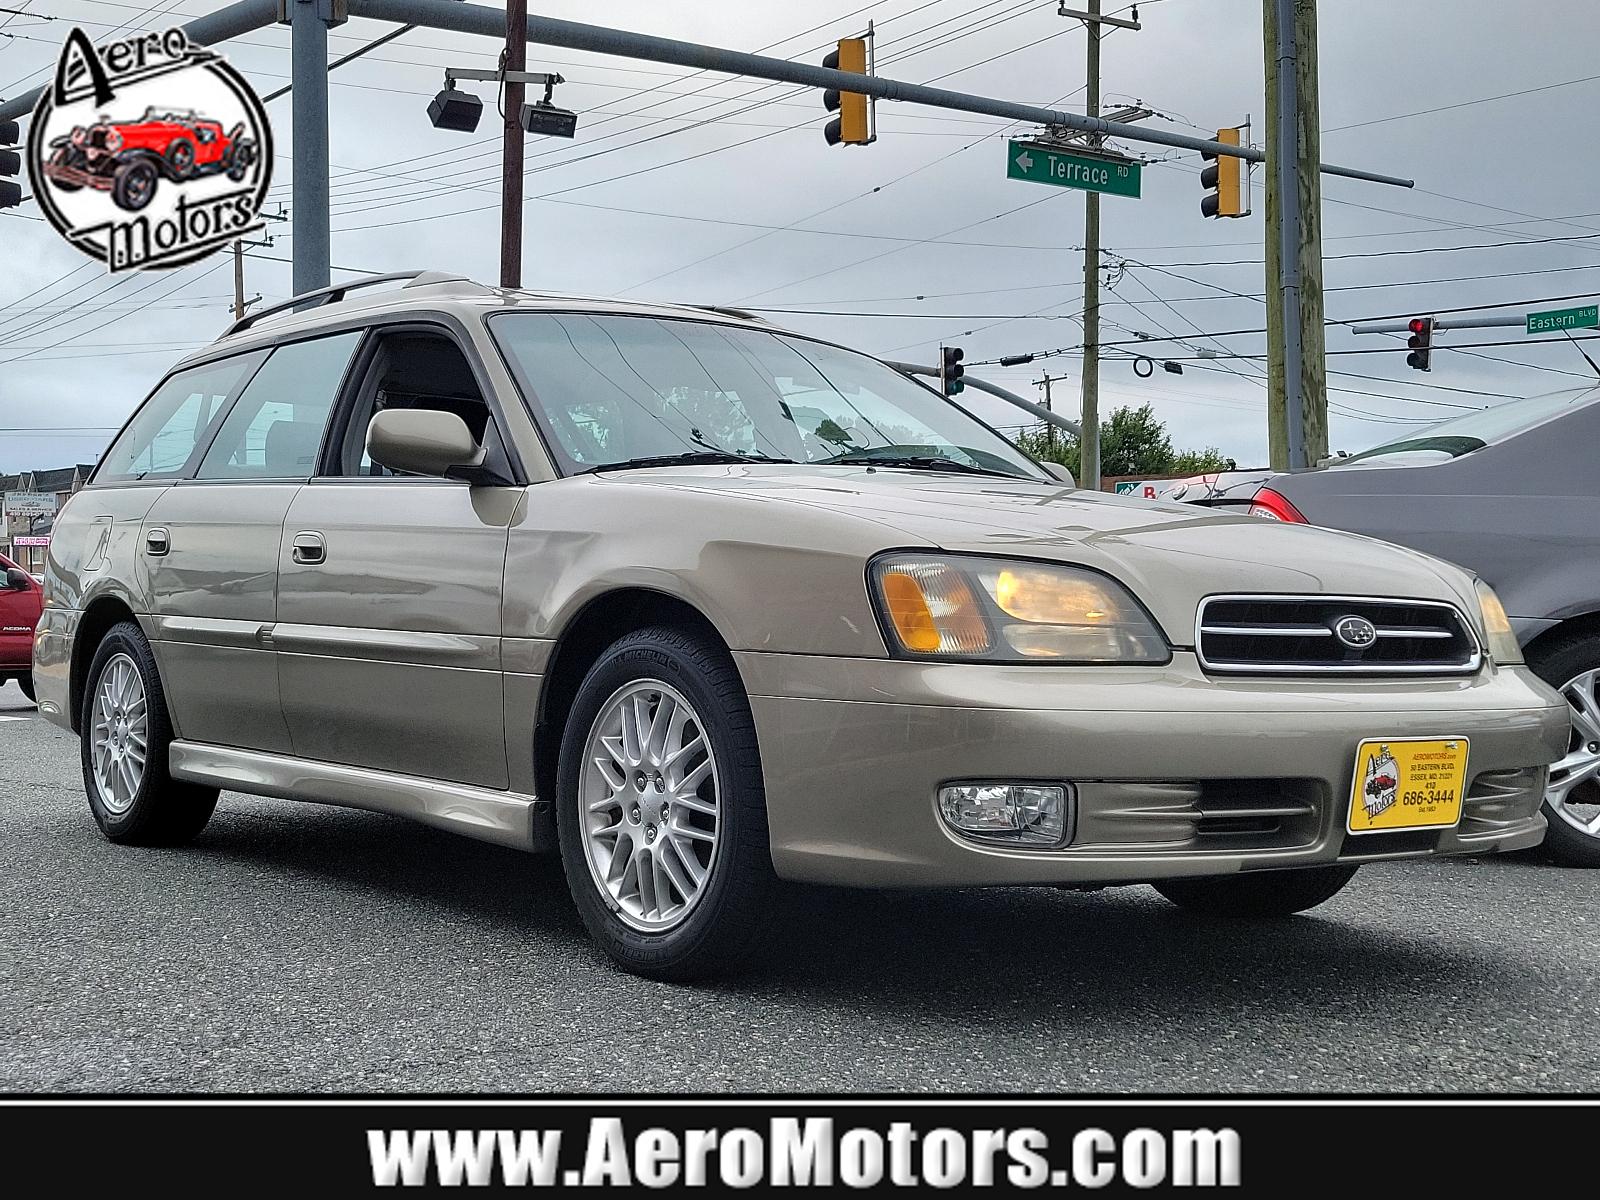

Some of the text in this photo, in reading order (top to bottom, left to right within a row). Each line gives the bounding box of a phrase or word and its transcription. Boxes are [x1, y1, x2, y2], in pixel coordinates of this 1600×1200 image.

[1048, 155, 1129, 185] Terrace RD
[1529, 308, 1597, 330] Eastern BLVD
[1403, 789, 1454, 806] 686-3444
